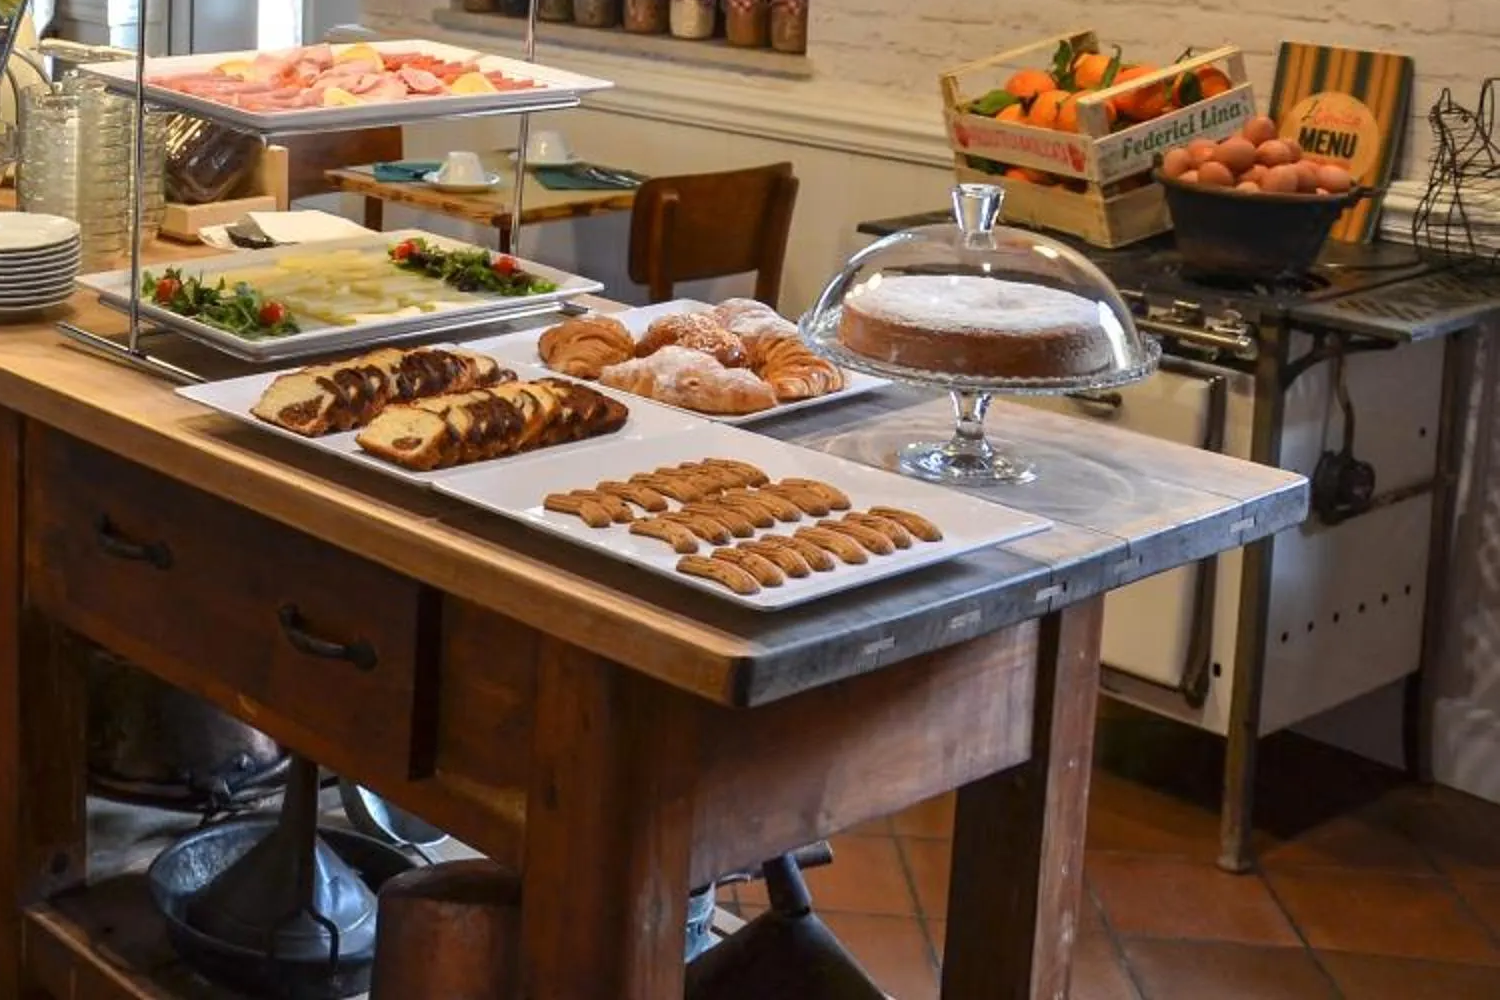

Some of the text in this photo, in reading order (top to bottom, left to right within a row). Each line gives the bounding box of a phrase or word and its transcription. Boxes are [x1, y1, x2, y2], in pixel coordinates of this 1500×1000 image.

[1122, 101, 1241, 160] Federici Lina
[1299, 125, 1358, 160] MENU
